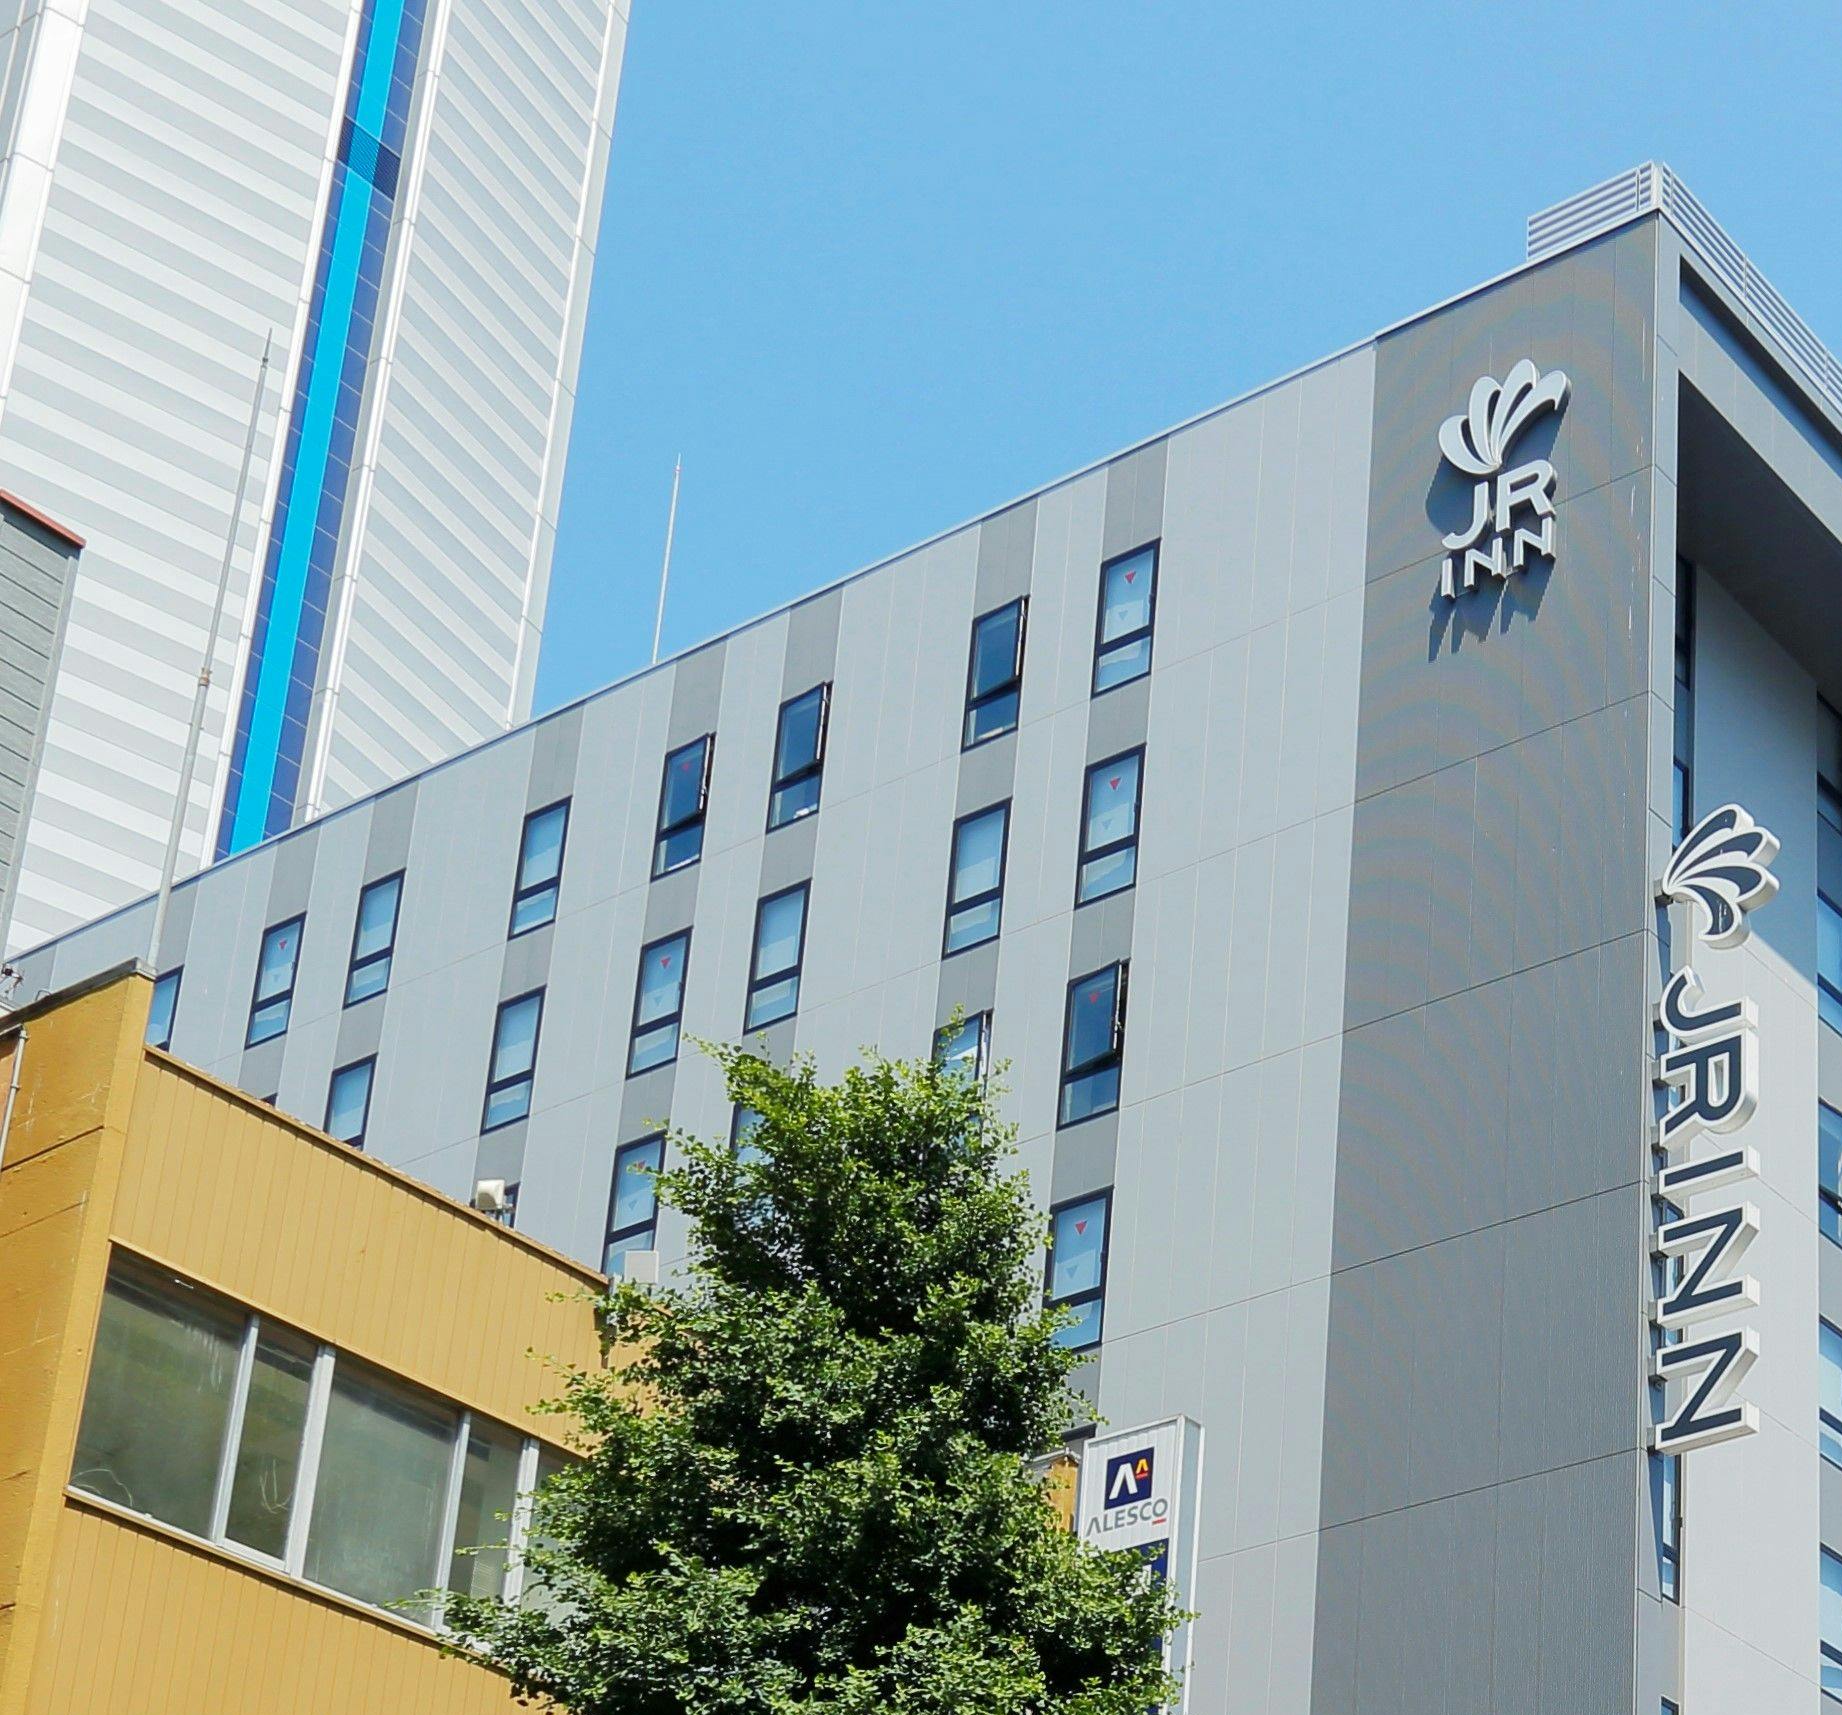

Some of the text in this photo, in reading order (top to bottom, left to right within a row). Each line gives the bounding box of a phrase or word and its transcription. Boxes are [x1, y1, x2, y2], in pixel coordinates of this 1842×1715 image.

[1441, 459, 1558, 550] JR
[1440, 517, 1557, 600] INN
[1085, 1498, 1169, 1537] ALESCO
